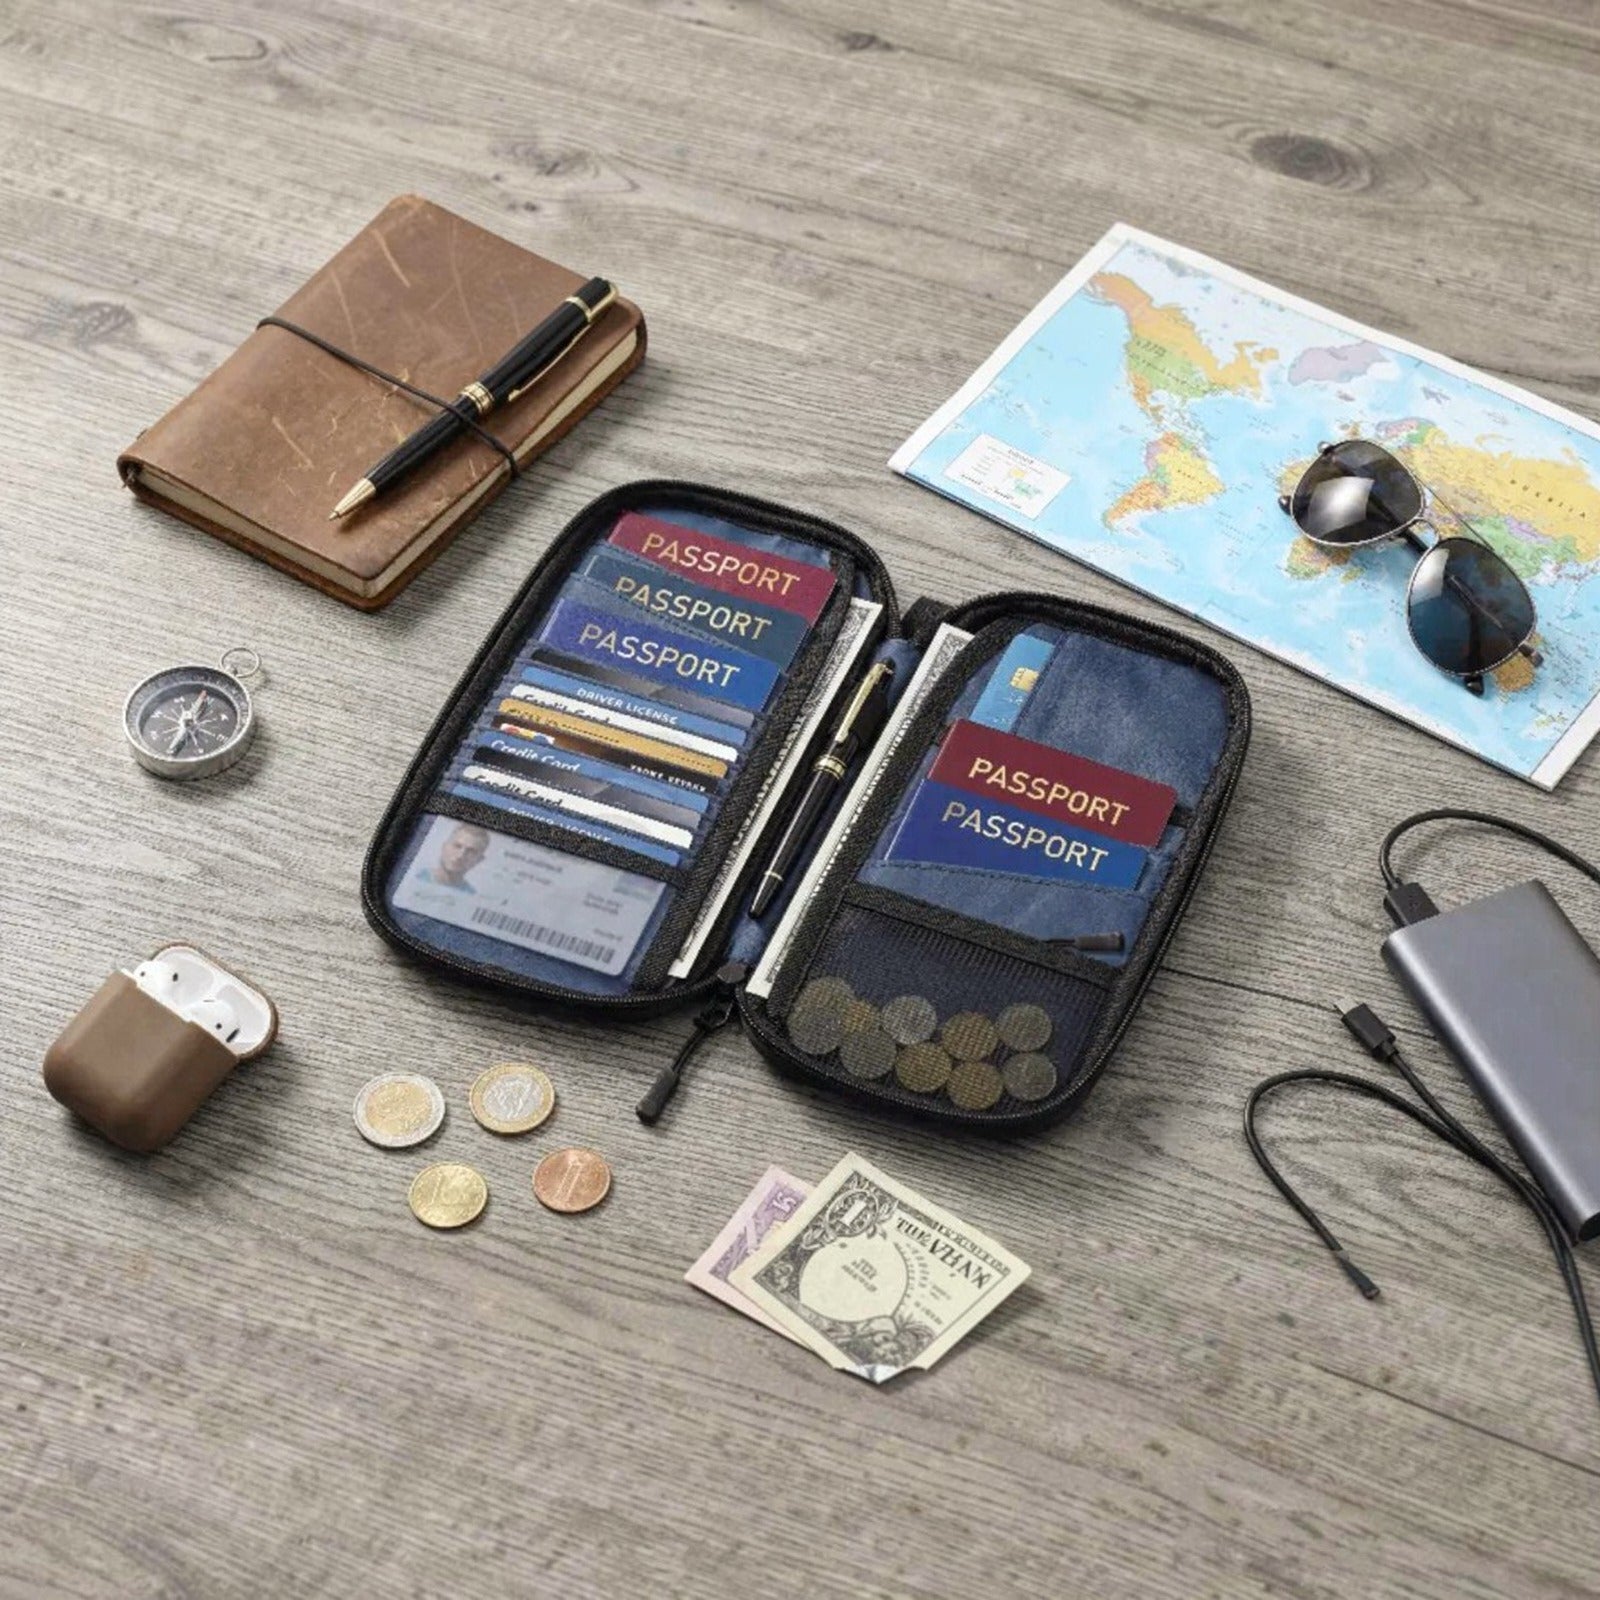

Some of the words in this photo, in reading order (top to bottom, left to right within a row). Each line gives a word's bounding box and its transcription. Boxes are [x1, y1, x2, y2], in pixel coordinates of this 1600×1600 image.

[641, 532, 800, 597] PASSPORT
[614, 577, 772, 641] PASSPORT
[578, 623, 741, 688] PASSPORT
[576, 687, 623, 708] DRIVER
[626, 702, 679, 725] LICENSE
[541, 755, 580, 771] Card
[968, 757, 1130, 826] PASSPORT
[941, 802, 1109, 872] PASSPORT
